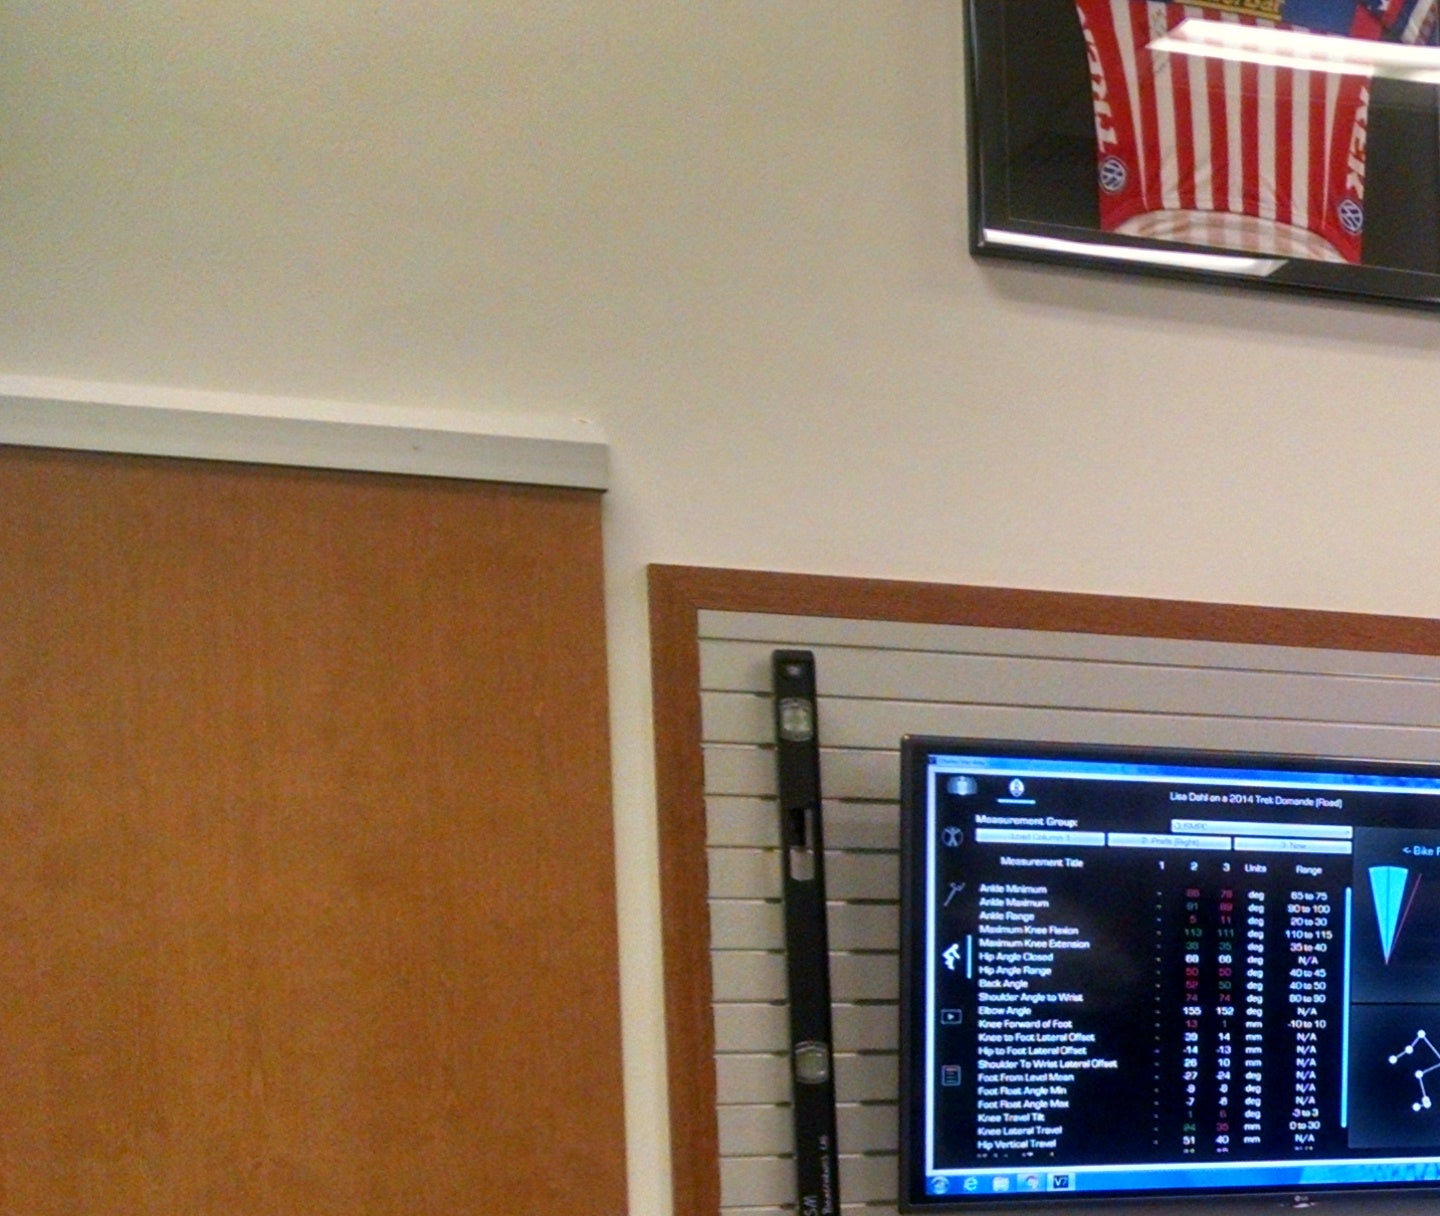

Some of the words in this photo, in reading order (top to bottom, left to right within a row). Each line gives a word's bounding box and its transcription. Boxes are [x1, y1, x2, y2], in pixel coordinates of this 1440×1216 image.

[1170, 792, 1187, 801] Lisa
[1189, 793, 1208, 802] Dahl
[1229, 794, 1253, 803] 2014
[1256, 795, 1274, 804] Trek
[975, 814, 1043, 825] Measurement
[1413, 845, 1433, 856] Bike
[1000, 856, 1063, 866] Measurement
[1064, 858, 1083, 867] Title
[1189, 862, 1198, 871] 2
[1222, 863, 1230, 871] 3
[1244, 864, 1266, 872] Units
[1296, 865, 1322, 876] Range
[979, 884, 1004, 893] Ankle
[1006, 885, 1047, 893] Minimum
[1248, 891, 1265, 900] deg
[979, 898, 1004, 906] Ankle
[1005, 898, 1049, 907] Maximum
[1247, 904, 1264, 913] deg
[979, 911, 1003, 920] Ankle
[1005, 912, 1034, 923] Range
[1247, 917, 1264, 926] deg
[979, 925, 1022, 933] Maximum
[1024, 925, 1047, 934] Knee
[1247, 930, 1264, 939] deg
[978, 939, 1022, 947] Maximum
[1023, 939, 1047, 947] Knee
[1246, 943, 1263, 952] deg
[978, 952, 994, 963] Hip
[996, 952, 1021, 963] Angle
[1023, 953, 1053, 961] Closed
[1246, 956, 1263, 965] deg
[1298, 956, 1318, 964] N/A
[978, 966, 994, 976] Hip
[995, 966, 1021, 976] Angle
[1023, 966, 1051, 977] Range
[1246, 968, 1263, 978] deg
[978, 979, 1001, 987] Back
[1003, 979, 1028, 990] Angle
[1246, 981, 1263, 990] deg
[978, 993, 1018, 1001] Shoulder
[1020, 993, 1045, 1003] Angle
[1057, 993, 1083, 1001] Wrist
[1245, 994, 1262, 1003] deg
[1006, 1007, 1031, 1017] Angle
[1245, 1007, 1262, 1016] deg
[1297, 1007, 1317, 1015] N/A
[978, 1020, 1002, 1028] Knee
[1052, 1020, 1072, 1028] Foot
[978, 1034, 1002, 1042] Knee
[1015, 1033, 1035, 1041] Foot
[1036, 1033, 1066, 1041] Lateral
[1296, 1032, 1317, 1041] N/A
[978, 1047, 993, 1058] Hip
[1006, 1047, 1026, 1055] Foot
[1028, 1046, 1058, 1055] Lateral
[1296, 1045, 1317, 1053] N/A
[977, 1060, 1017, 1069] Shoulder
[1032, 1060, 1058, 1068] Wrist
[1059, 1059, 1090, 1068] Lateral
[1218, 1058, 1230, 1066] 10
[1296, 1057, 1316, 1066] N/A
[978, 1074, 998, 1082] Foot
[1000, 1073, 1023, 1082] From
[1049, 1073, 1074, 1081] Mean
[1244, 1071, 1261, 1080] deg
[1295, 1070, 1316, 1079] N/A
[977, 1087, 998, 1096] Foot
[1023, 1086, 1048, 1097] Angle
[1050, 1086, 1066, 1094] Min
[1243, 1084, 1260, 1093] deg
[1295, 1083, 1316, 1091] N/A
[1243, 1096, 1260, 1106] deg
[1295, 1095, 1315, 1104] N/A
[977, 1101, 998, 1109] Foot
[1023, 1100, 1048, 1111] Angle
[1049, 1099, 1069, 1108] Max
[977, 1114, 1001, 1123] Knee
[1003, 1113, 1030, 1122] Travel
[1243, 1109, 1260, 1119] deg
[977, 1127, 1001, 1136] Knee
[1003, 1127, 1034, 1135] Lateral
[1035, 1126, 1062, 1135] Travel
[1215, 1135, 1228, 1143] 40
[1294, 1133, 1315, 1142] N/A
[977, 1141, 993, 1152] Hip
